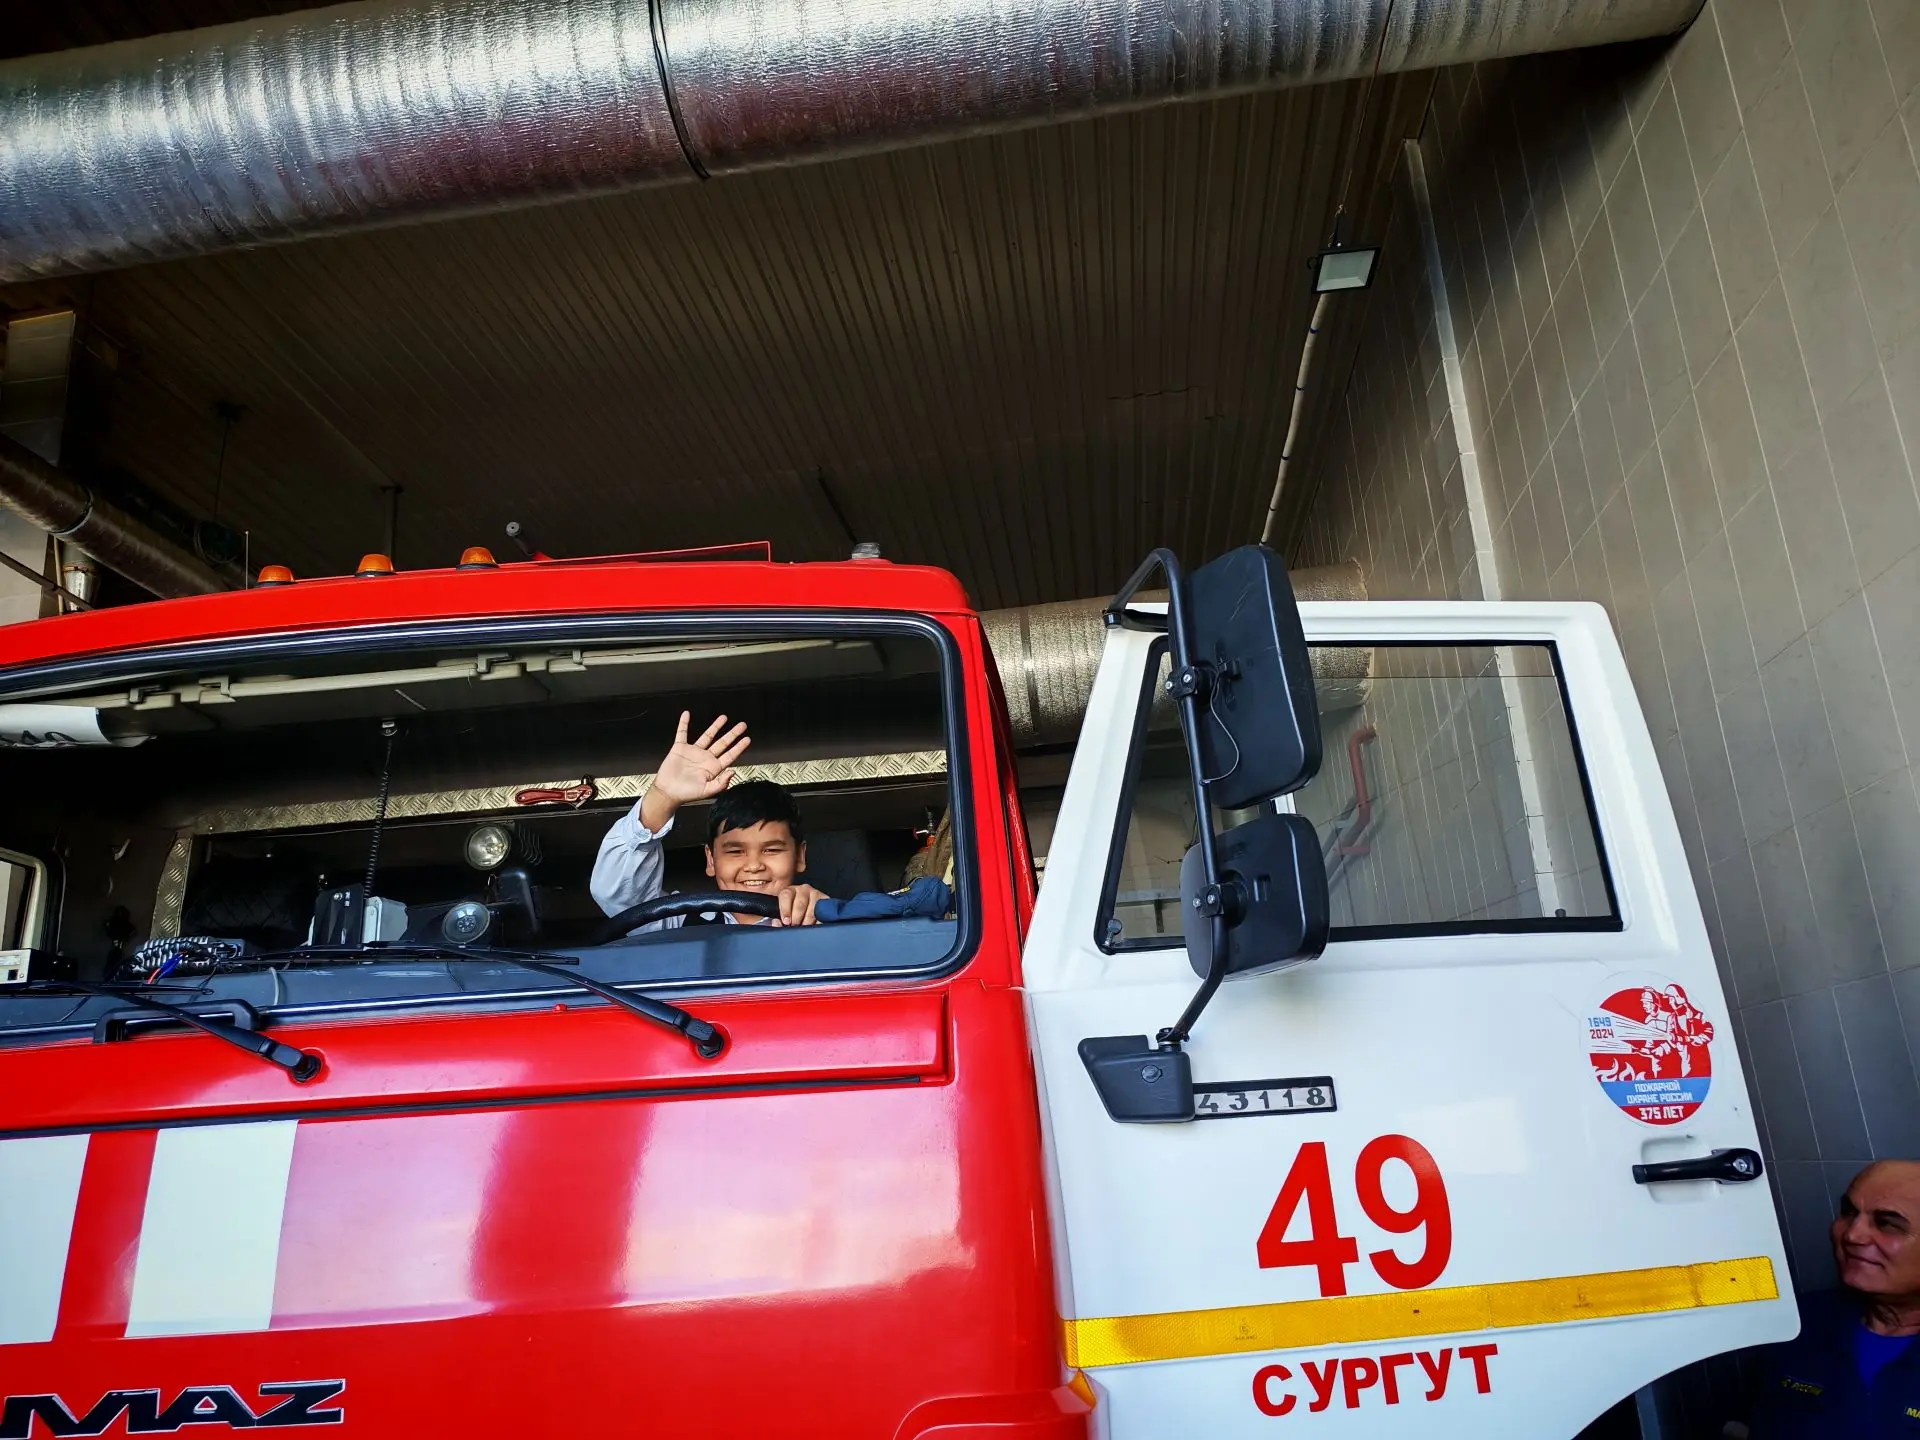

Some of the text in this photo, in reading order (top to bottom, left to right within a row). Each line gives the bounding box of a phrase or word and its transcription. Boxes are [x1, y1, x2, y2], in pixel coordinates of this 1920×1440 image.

[1588, 1017, 1611, 1027] 1649
[1590, 1028, 1614, 1039] 2024
[1634, 1080, 1681, 1092] ПОЖАРНОЙ
[1198, 1087, 1326, 1112] 43118
[1626, 1092, 1693, 1104] ОХРАНЕ РОССИИ
[1639, 1106, 1684, 1120] 375 ЛЕТ
[1256, 1133, 1452, 1298] 49
[1252, 1343, 1499, 1417] СУРГУТ
